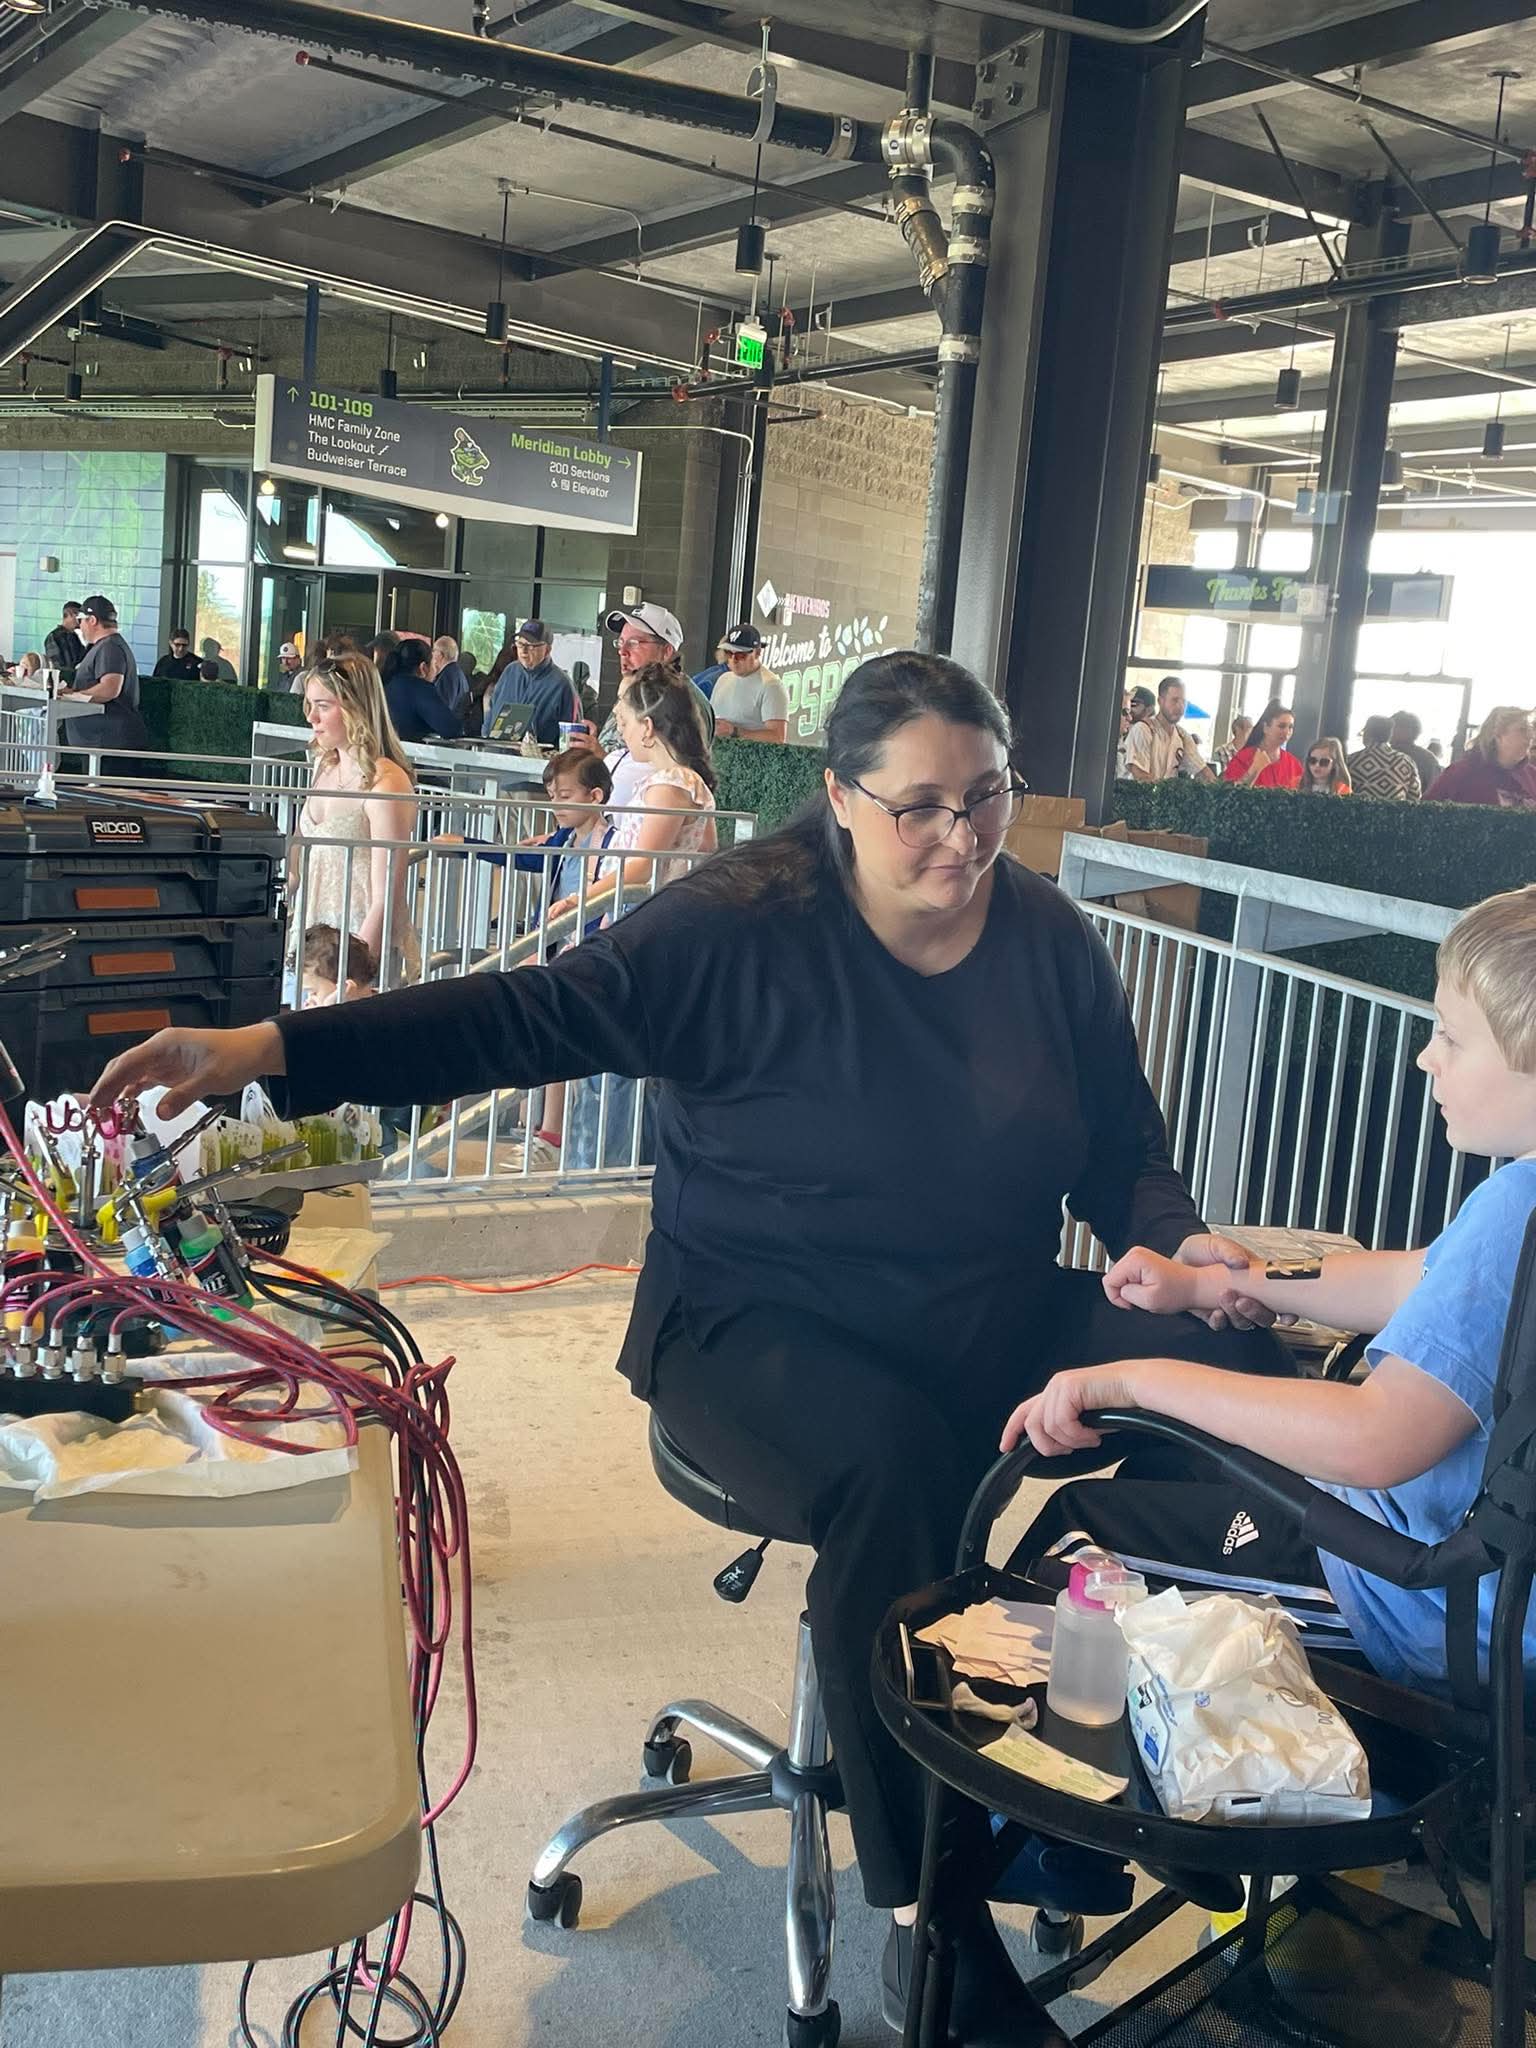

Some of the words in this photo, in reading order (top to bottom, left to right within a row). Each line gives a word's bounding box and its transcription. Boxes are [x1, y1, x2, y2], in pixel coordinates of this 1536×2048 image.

[309, 391, 373, 418] 101-109
[308, 413, 335, 430] HMC
[337, 419, 372, 439] Family
[374, 426, 401, 442] Zone
[308, 430, 329, 446] The
[331, 435, 376, 454] Lookout
[511, 432, 570, 458] Meridian
[573, 445, 612, 469] Lobby
[307, 447, 365, 469] Budweiser
[367, 458, 407, 477] Terrace
[549, 461, 569, 475] 200
[570, 465, 610, 483] Sections
[572, 481, 609, 498] Elevator
[1206, 577, 1268, 604] Thanks
[759, 632, 816, 669] Welcome
[818, 625, 833, 659] to
[91, 821, 141, 834] RIDGID
[1222, 1511, 1247, 1555] adidas
